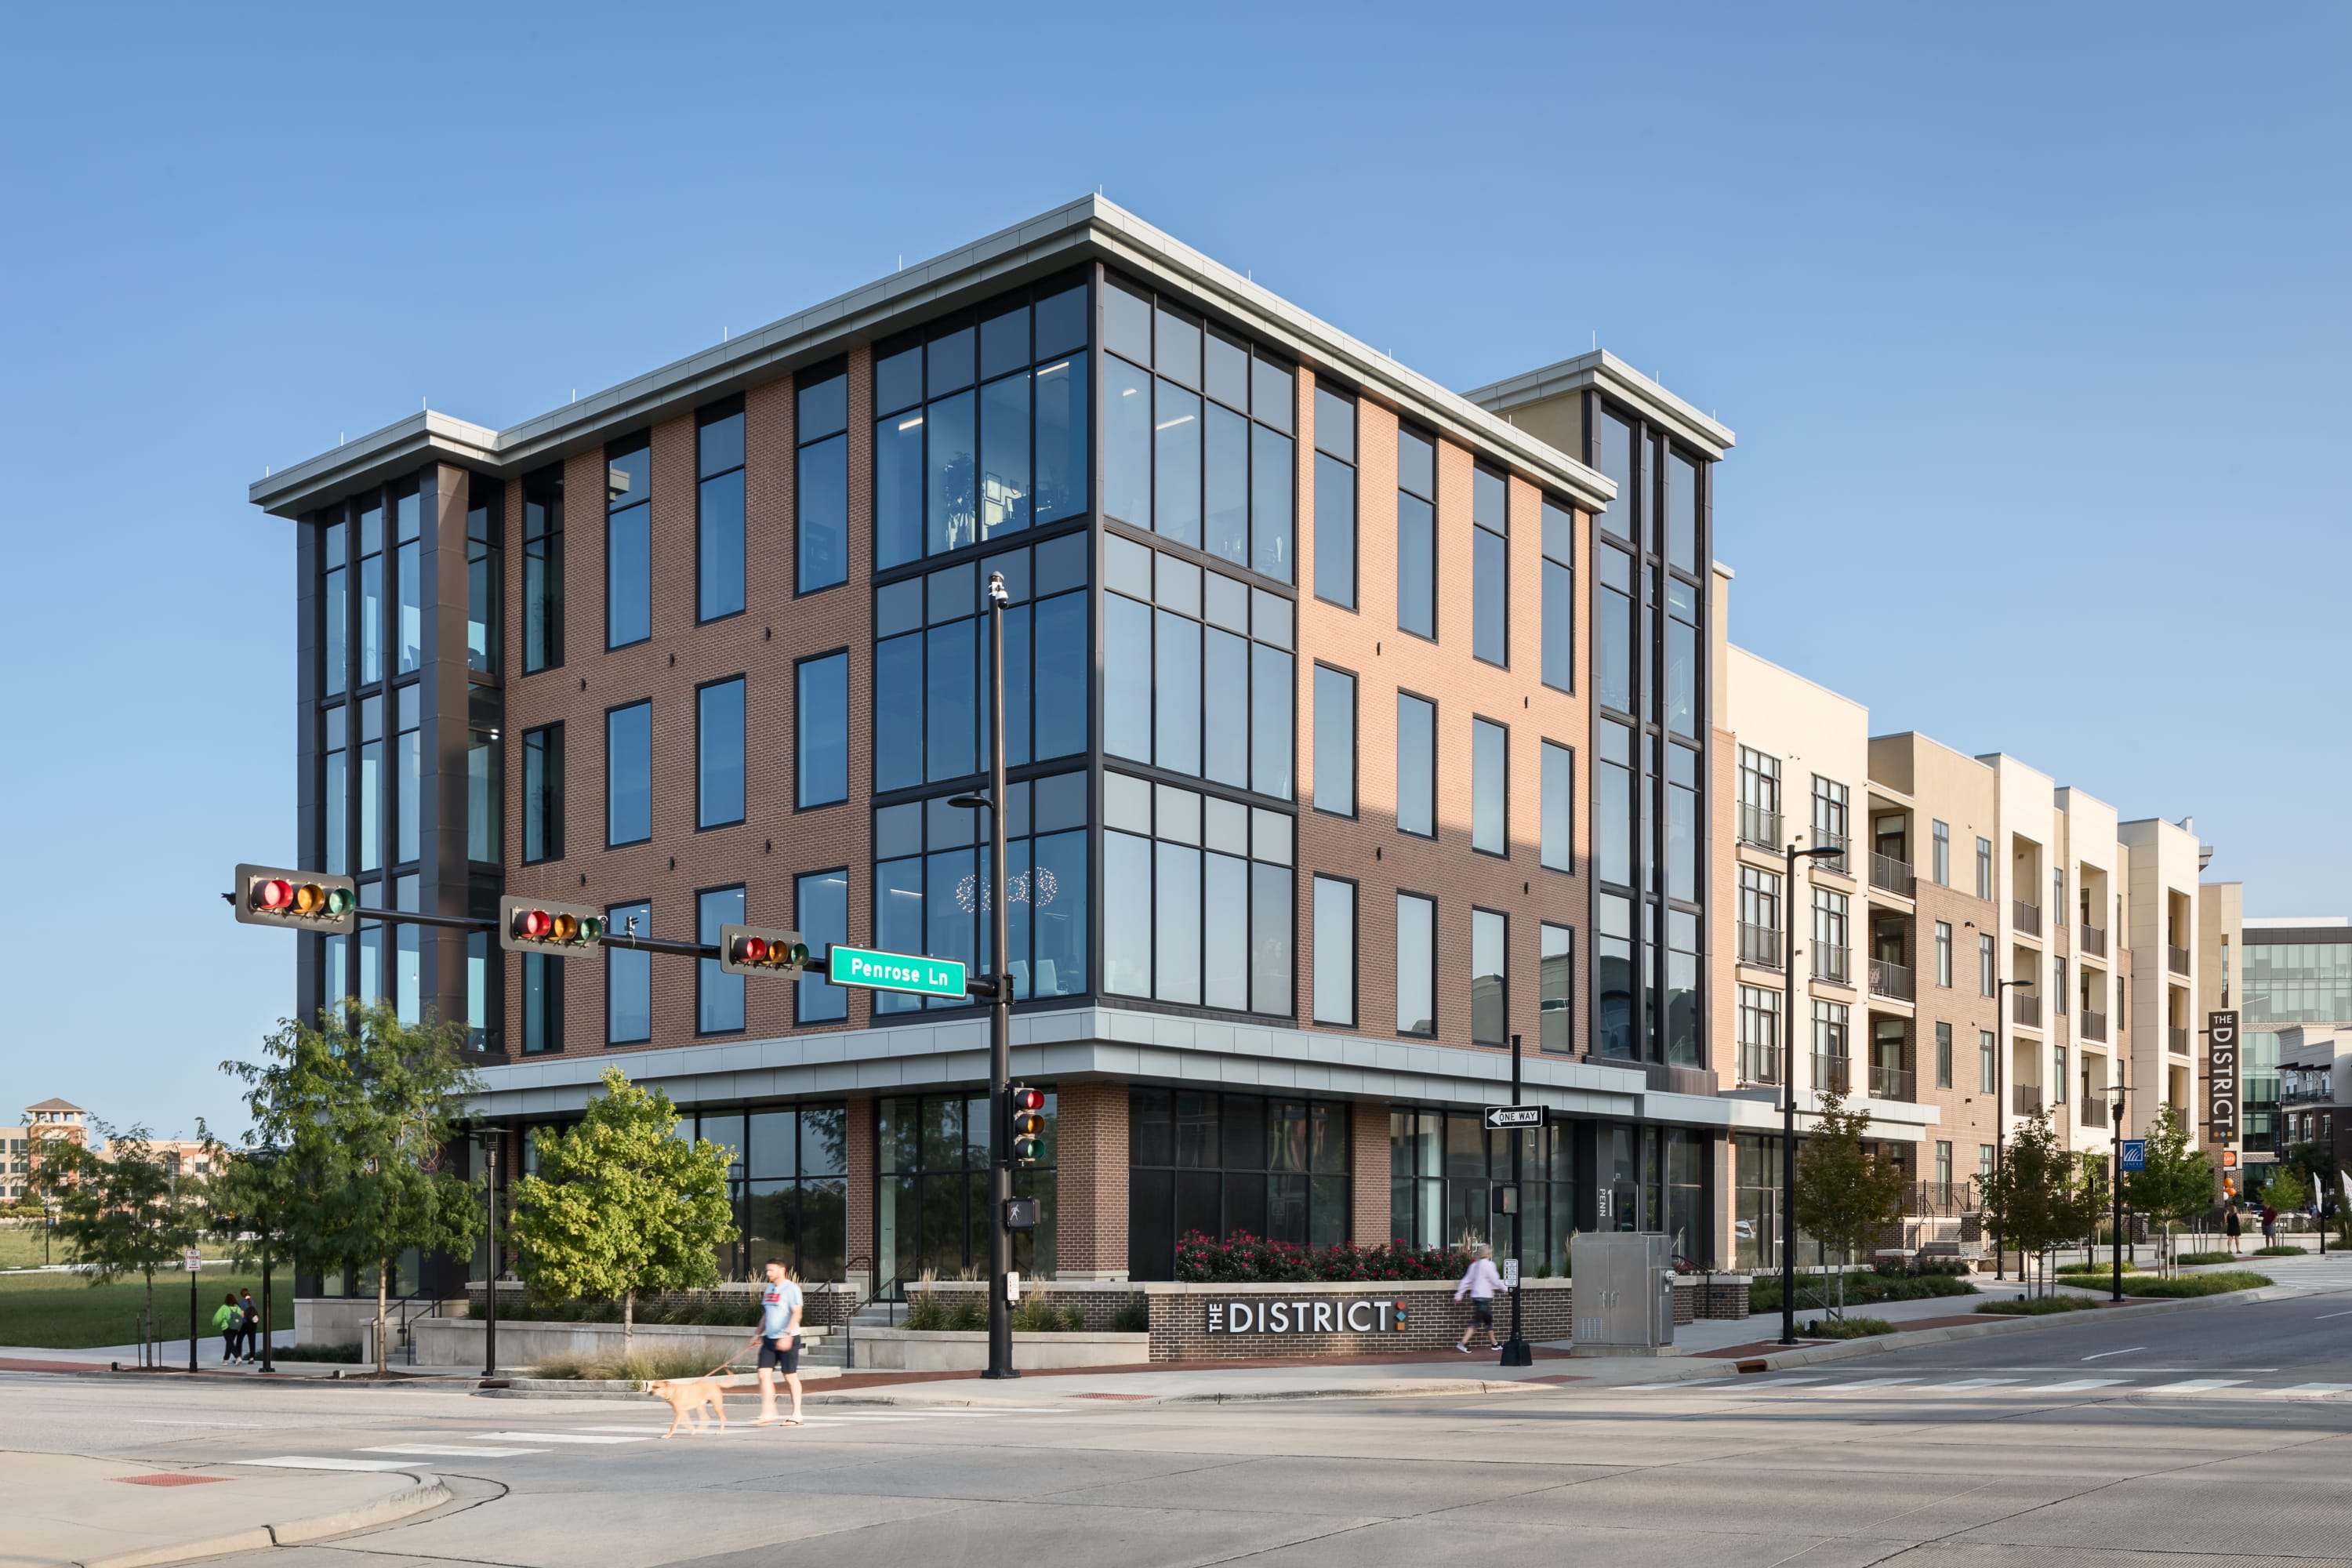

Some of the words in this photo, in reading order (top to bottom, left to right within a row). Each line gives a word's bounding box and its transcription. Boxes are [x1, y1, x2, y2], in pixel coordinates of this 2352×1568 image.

[851, 957, 920, 982] Penrose
[928, 967, 947, 985] Ln
[2213, 1014, 2232, 1025] THE
[2212, 1027, 2233, 1127] DISTRICT
[1499, 1112, 1515, 1122] ONE
[1519, 1112, 1536, 1121] WAY
[1209, 1303, 1223, 1333] THE
[1229, 1301, 1392, 1333] DISTRICT
